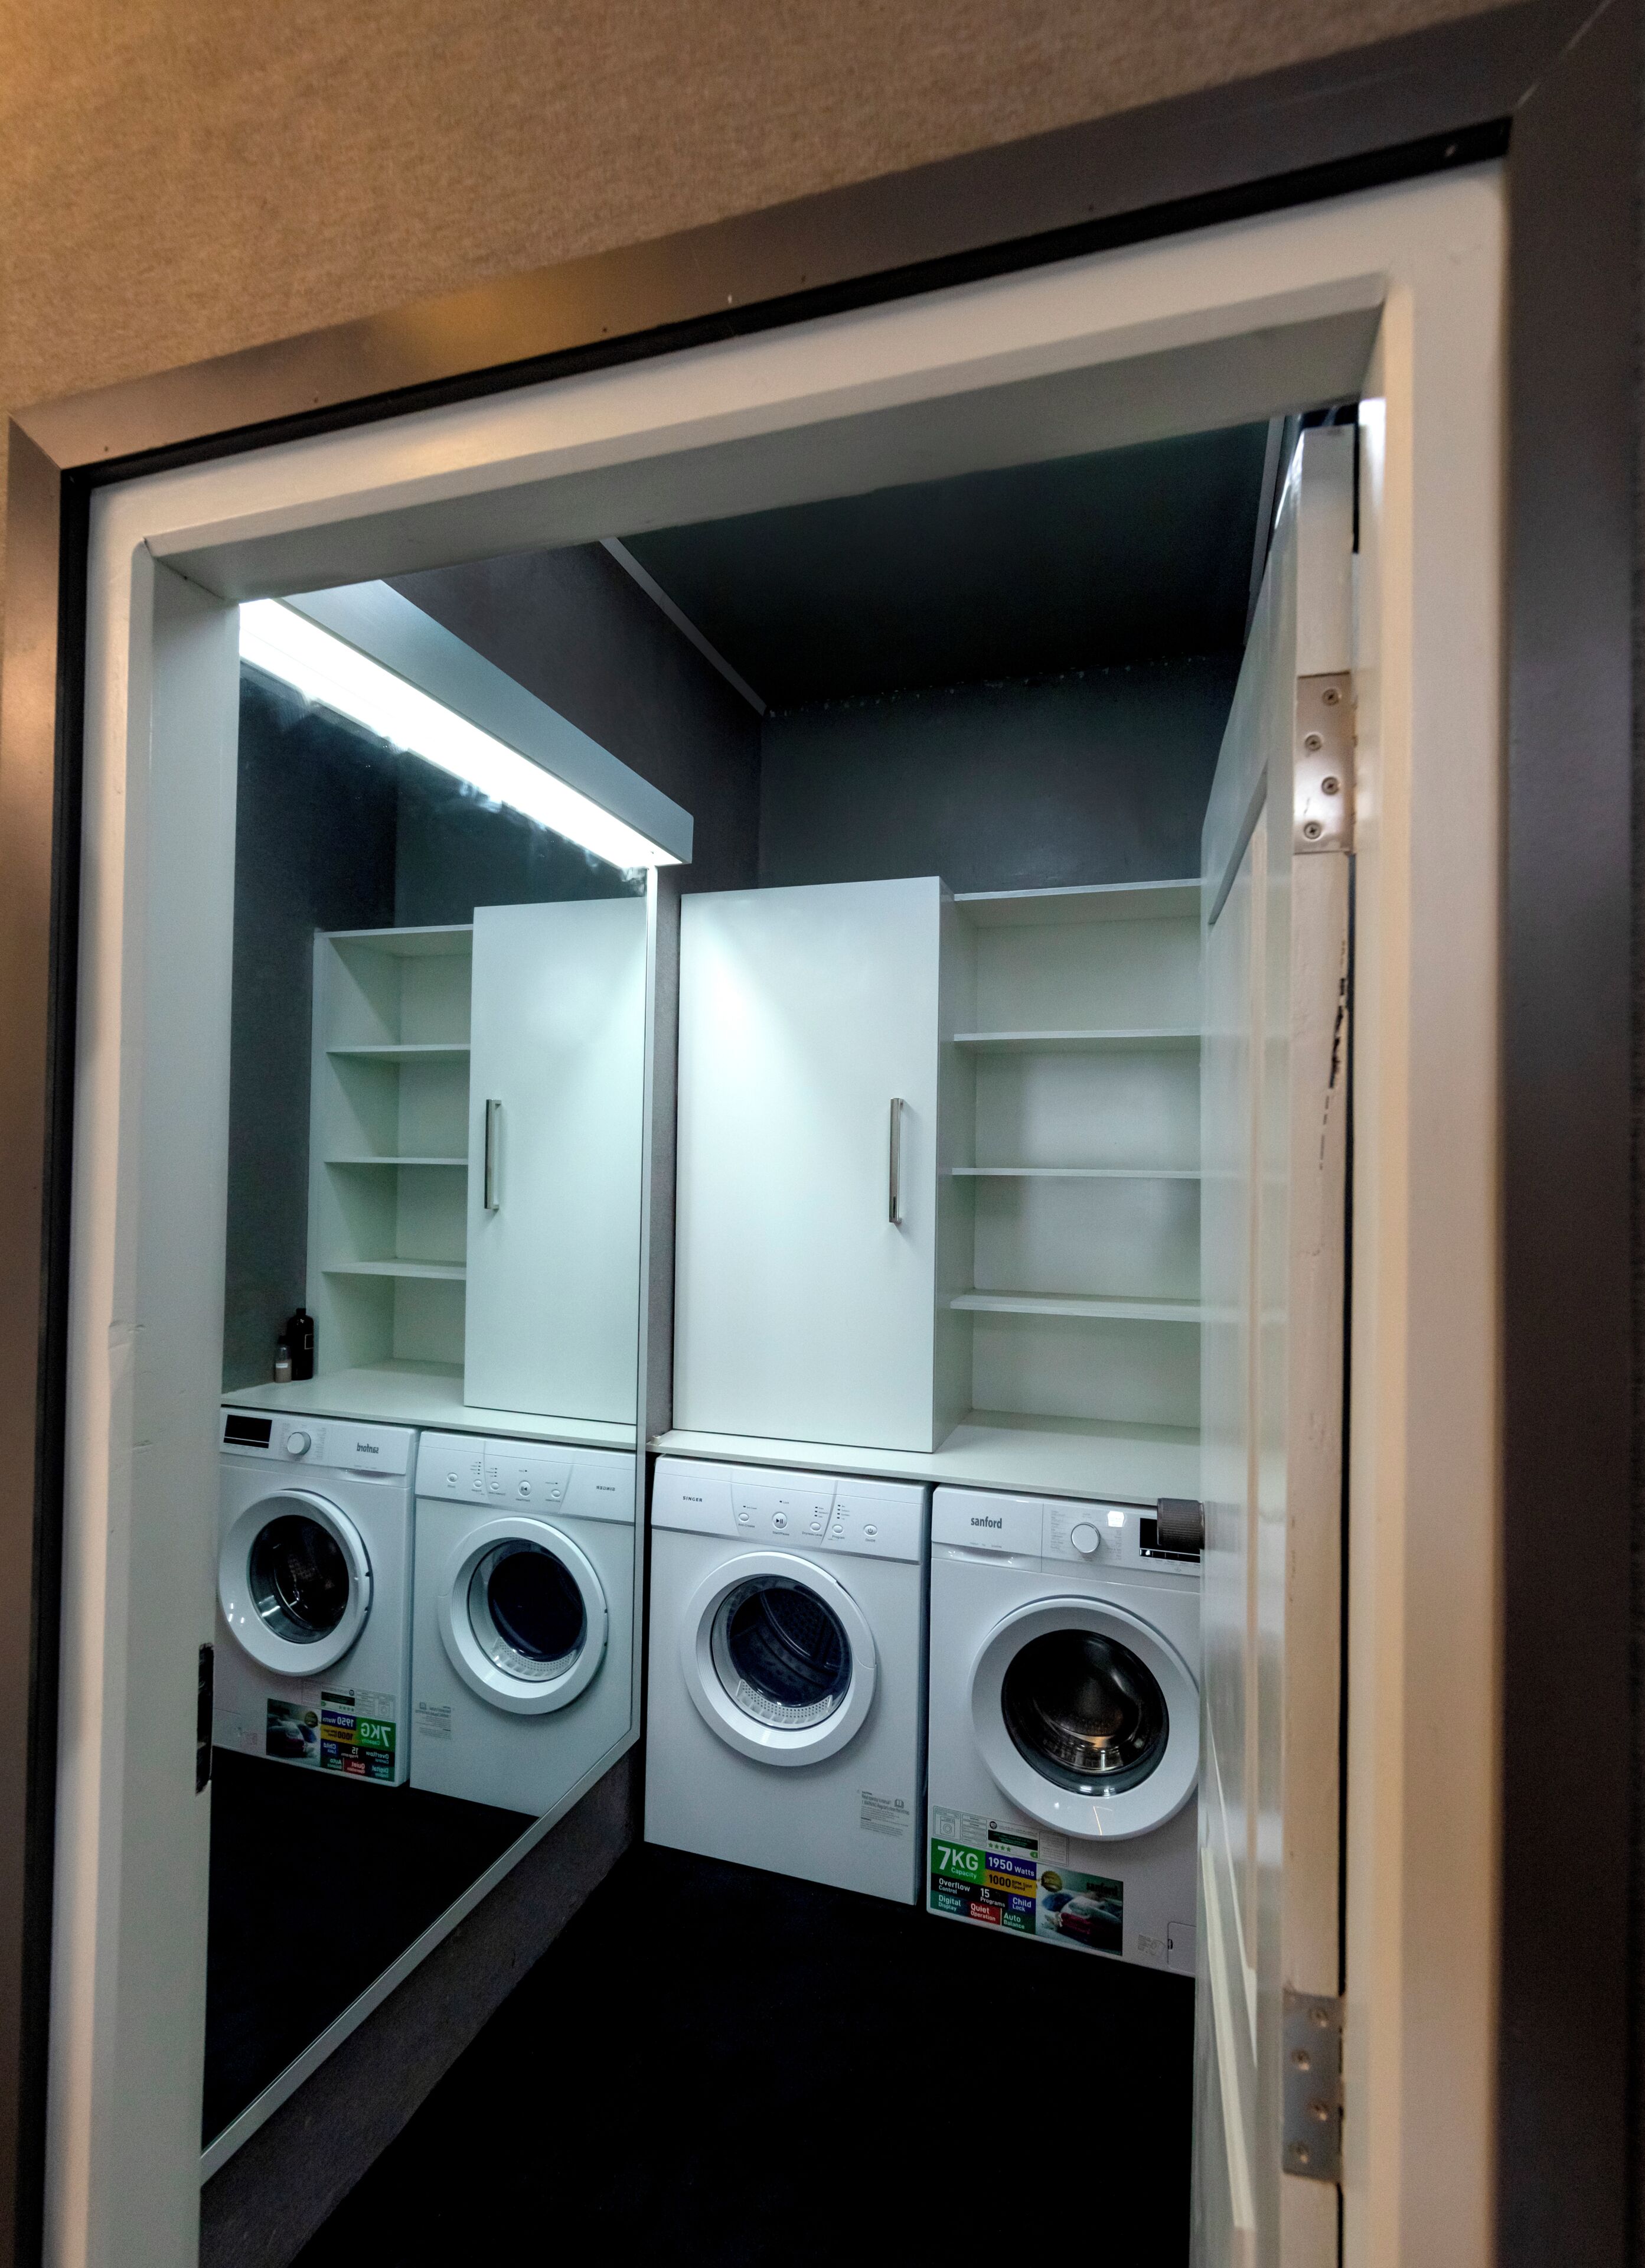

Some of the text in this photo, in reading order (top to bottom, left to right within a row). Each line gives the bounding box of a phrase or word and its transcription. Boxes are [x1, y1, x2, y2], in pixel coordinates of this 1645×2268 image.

[971, 1516, 1002, 1529] sanford
[938, 1846, 978, 1871] 7KG
[988, 1856, 1035, 1877] 1950 Watts
[951, 1867, 977, 1879] Capacity
[939, 1878, 970, 1892] Overflow
[989, 1874, 1011, 1888] 1000
[939, 1884, 958, 1895] Control
[980, 1888, 990, 1898] 15
[1086, 1882, 1118, 1896] sanford
[938, 1901, 957, 1912] Display
[939, 1894, 961, 1907] Digital
[980, 1896, 1006, 1908] Programs
[1012, 1897, 1032, 1908] Child
[971, 1903, 990, 1914] Quiet
[970, 1910, 996, 1922] Operation
[1004, 1912, 1021, 1923] Auto
[1003, 1920, 1026, 1930] Balance
